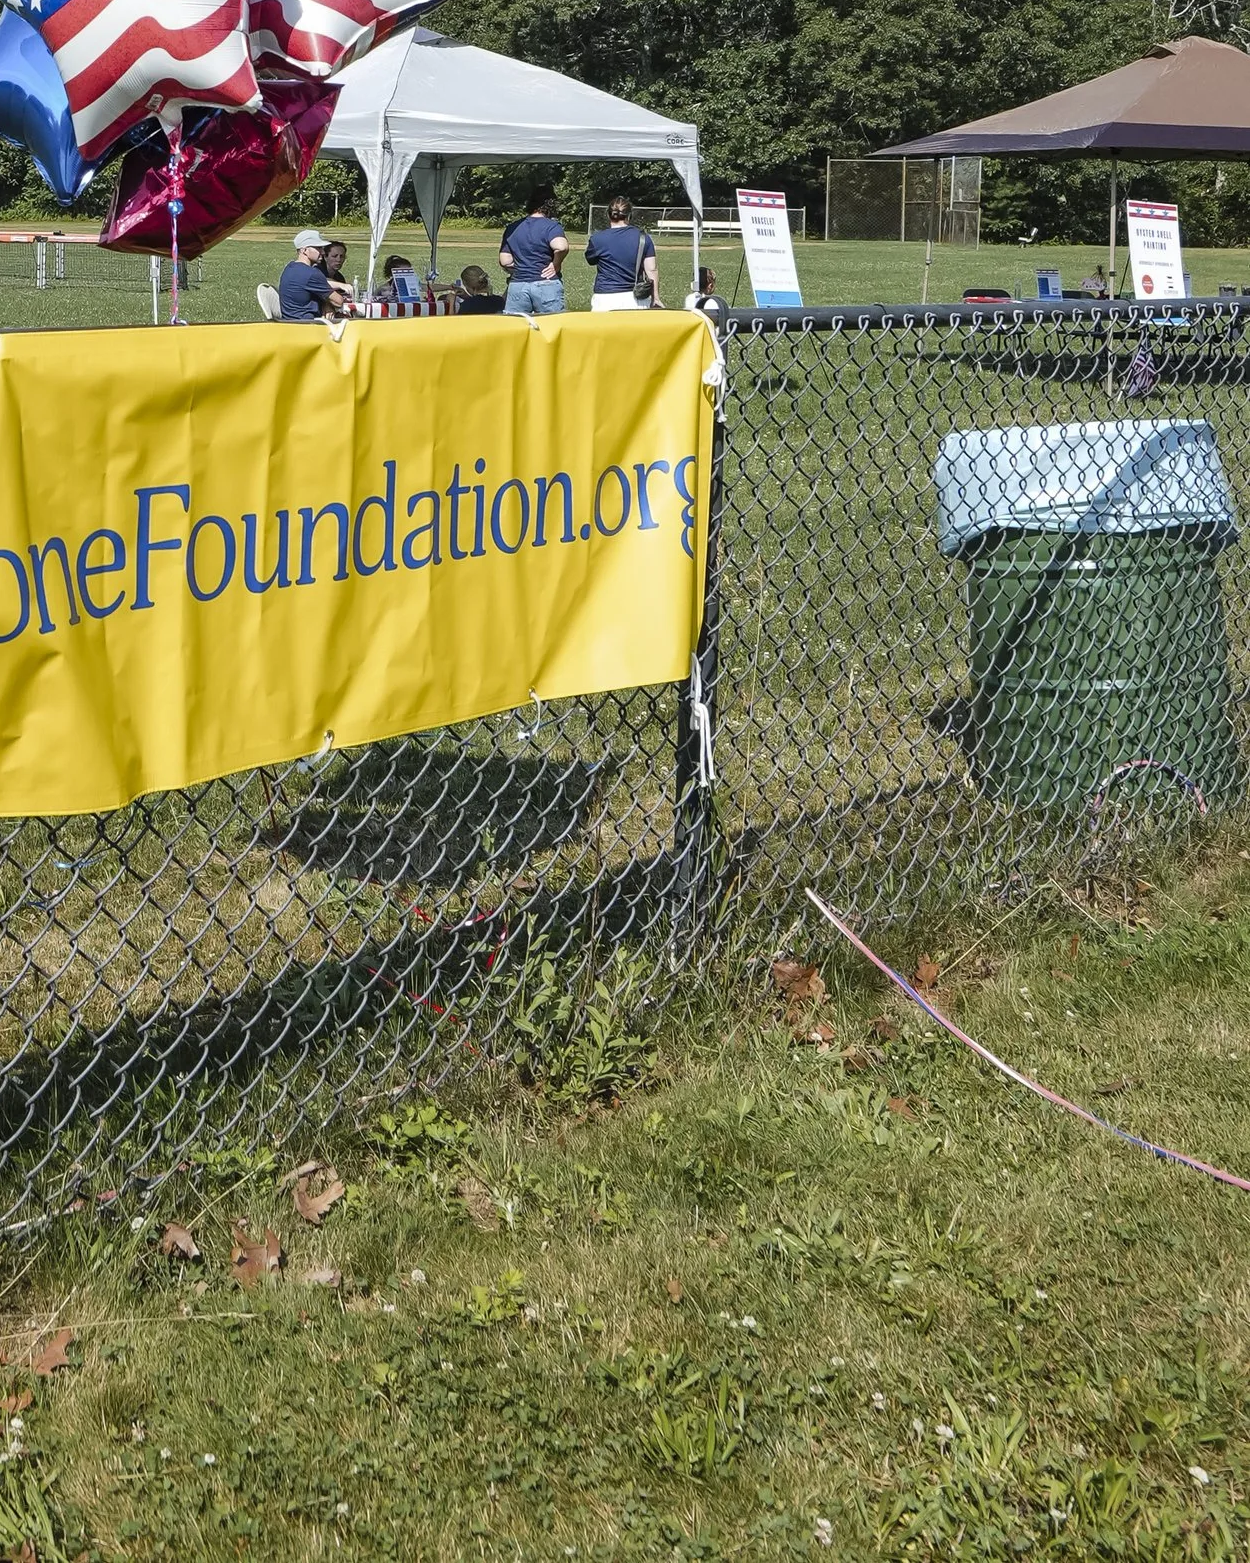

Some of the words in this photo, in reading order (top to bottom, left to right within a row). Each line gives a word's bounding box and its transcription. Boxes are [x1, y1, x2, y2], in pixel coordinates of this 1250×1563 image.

[1136, 228, 1155, 238] OYSTER
[1157, 230, 1172, 239] SHELL
[1143, 241, 1166, 250] PAINTING
